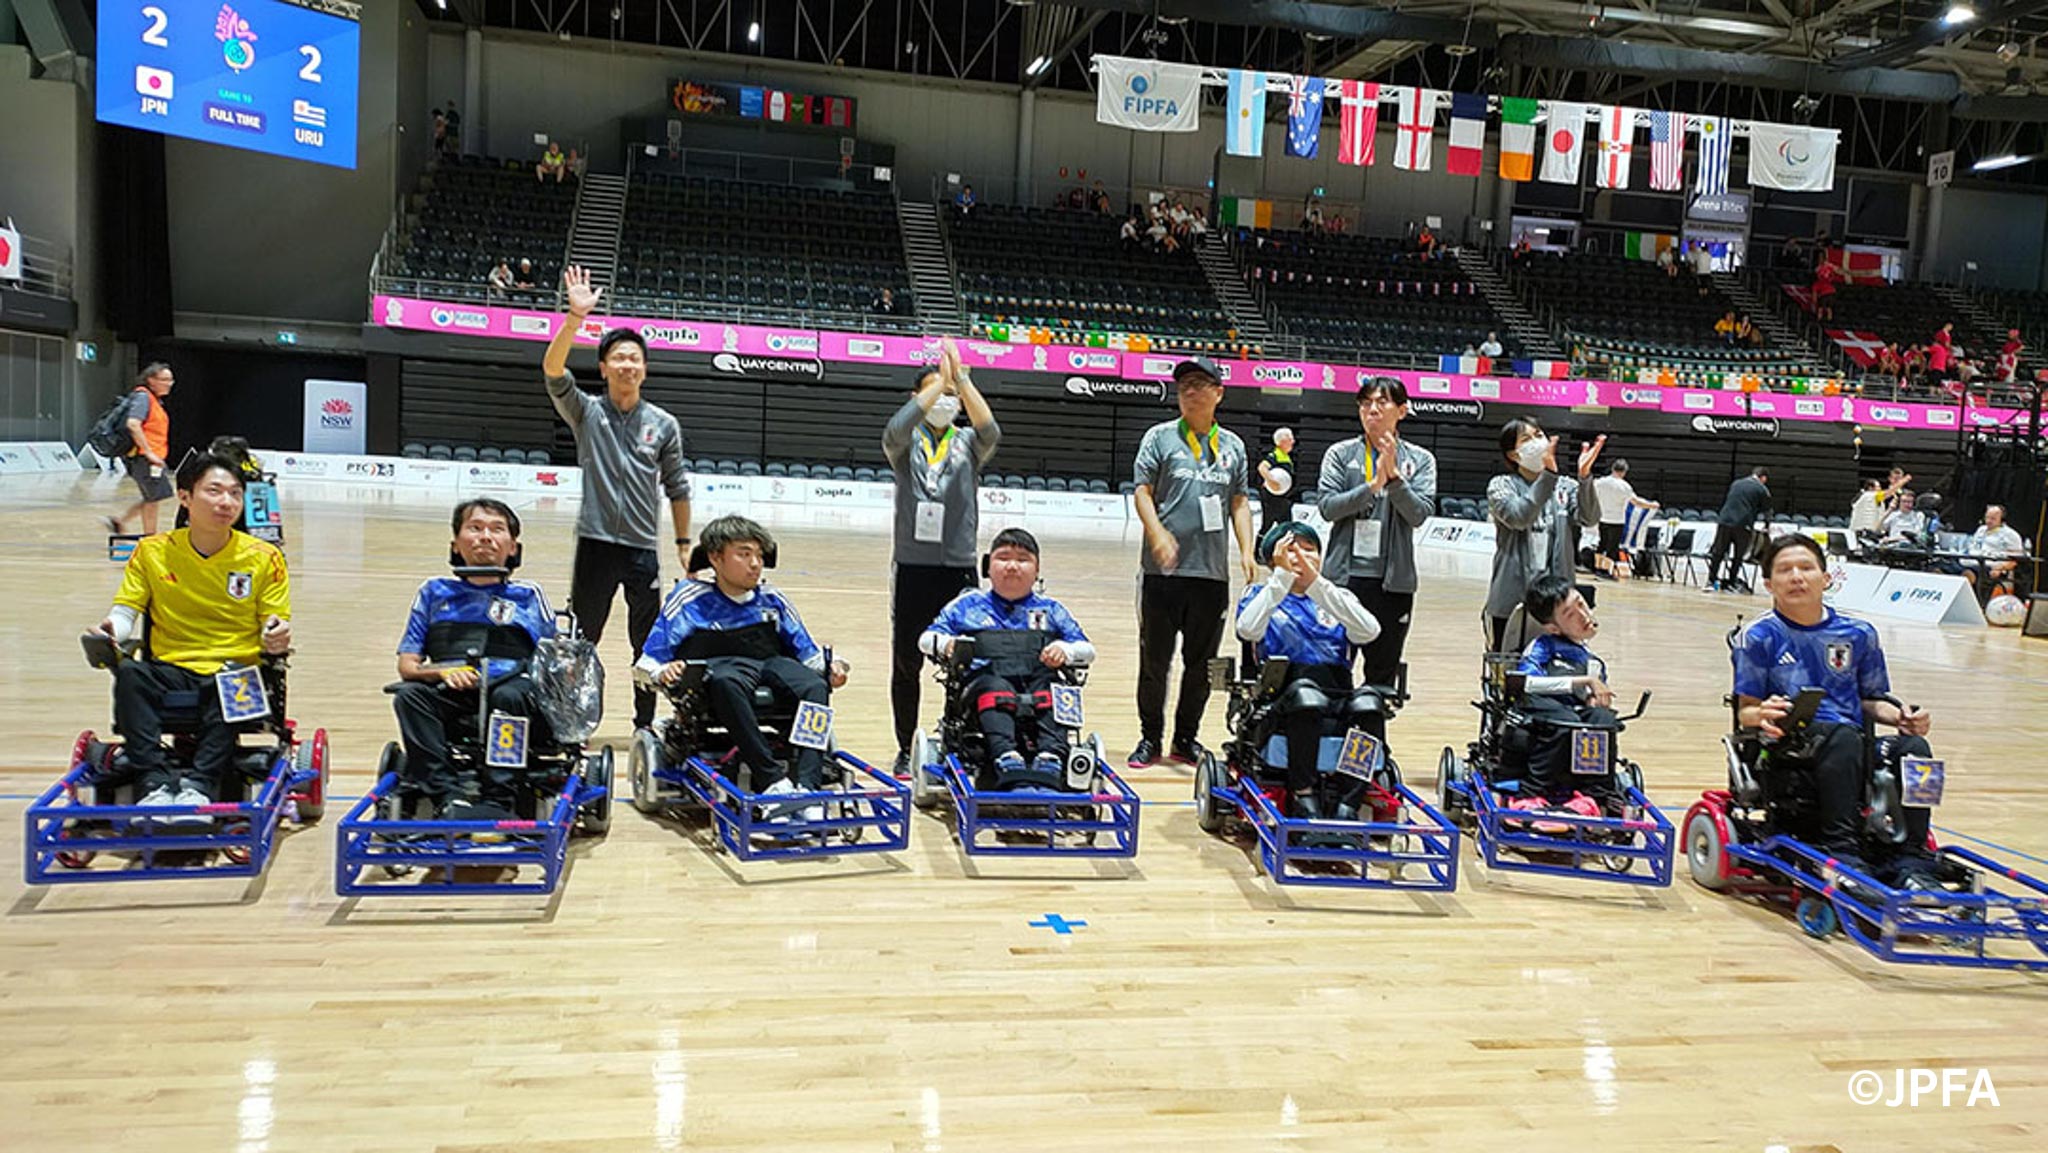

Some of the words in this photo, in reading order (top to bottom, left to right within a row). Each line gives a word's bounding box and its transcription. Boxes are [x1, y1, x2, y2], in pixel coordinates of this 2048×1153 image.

[141, 5, 169, 48] 2
[298, 44, 322, 83] 2
[141, 97, 168, 116] JPN
[1123, 95, 1178, 116] FIPFA
[209, 106, 235, 124] FULL
[235, 112, 261, 129] TIME
[294, 127, 324, 147] URU
[1933, 165, 1949, 181] 10
[321, 415, 353, 426] NSW
[1908, 587, 1943, 602] FIPFA
[1061, 690, 1075, 711] 9
[802, 709, 828, 734] 10
[498, 722, 515, 750] 8
[1347, 736, 1374, 762] 17
[1580, 736, 1601, 759] 11
[1915, 765, 1932, 785] 7
